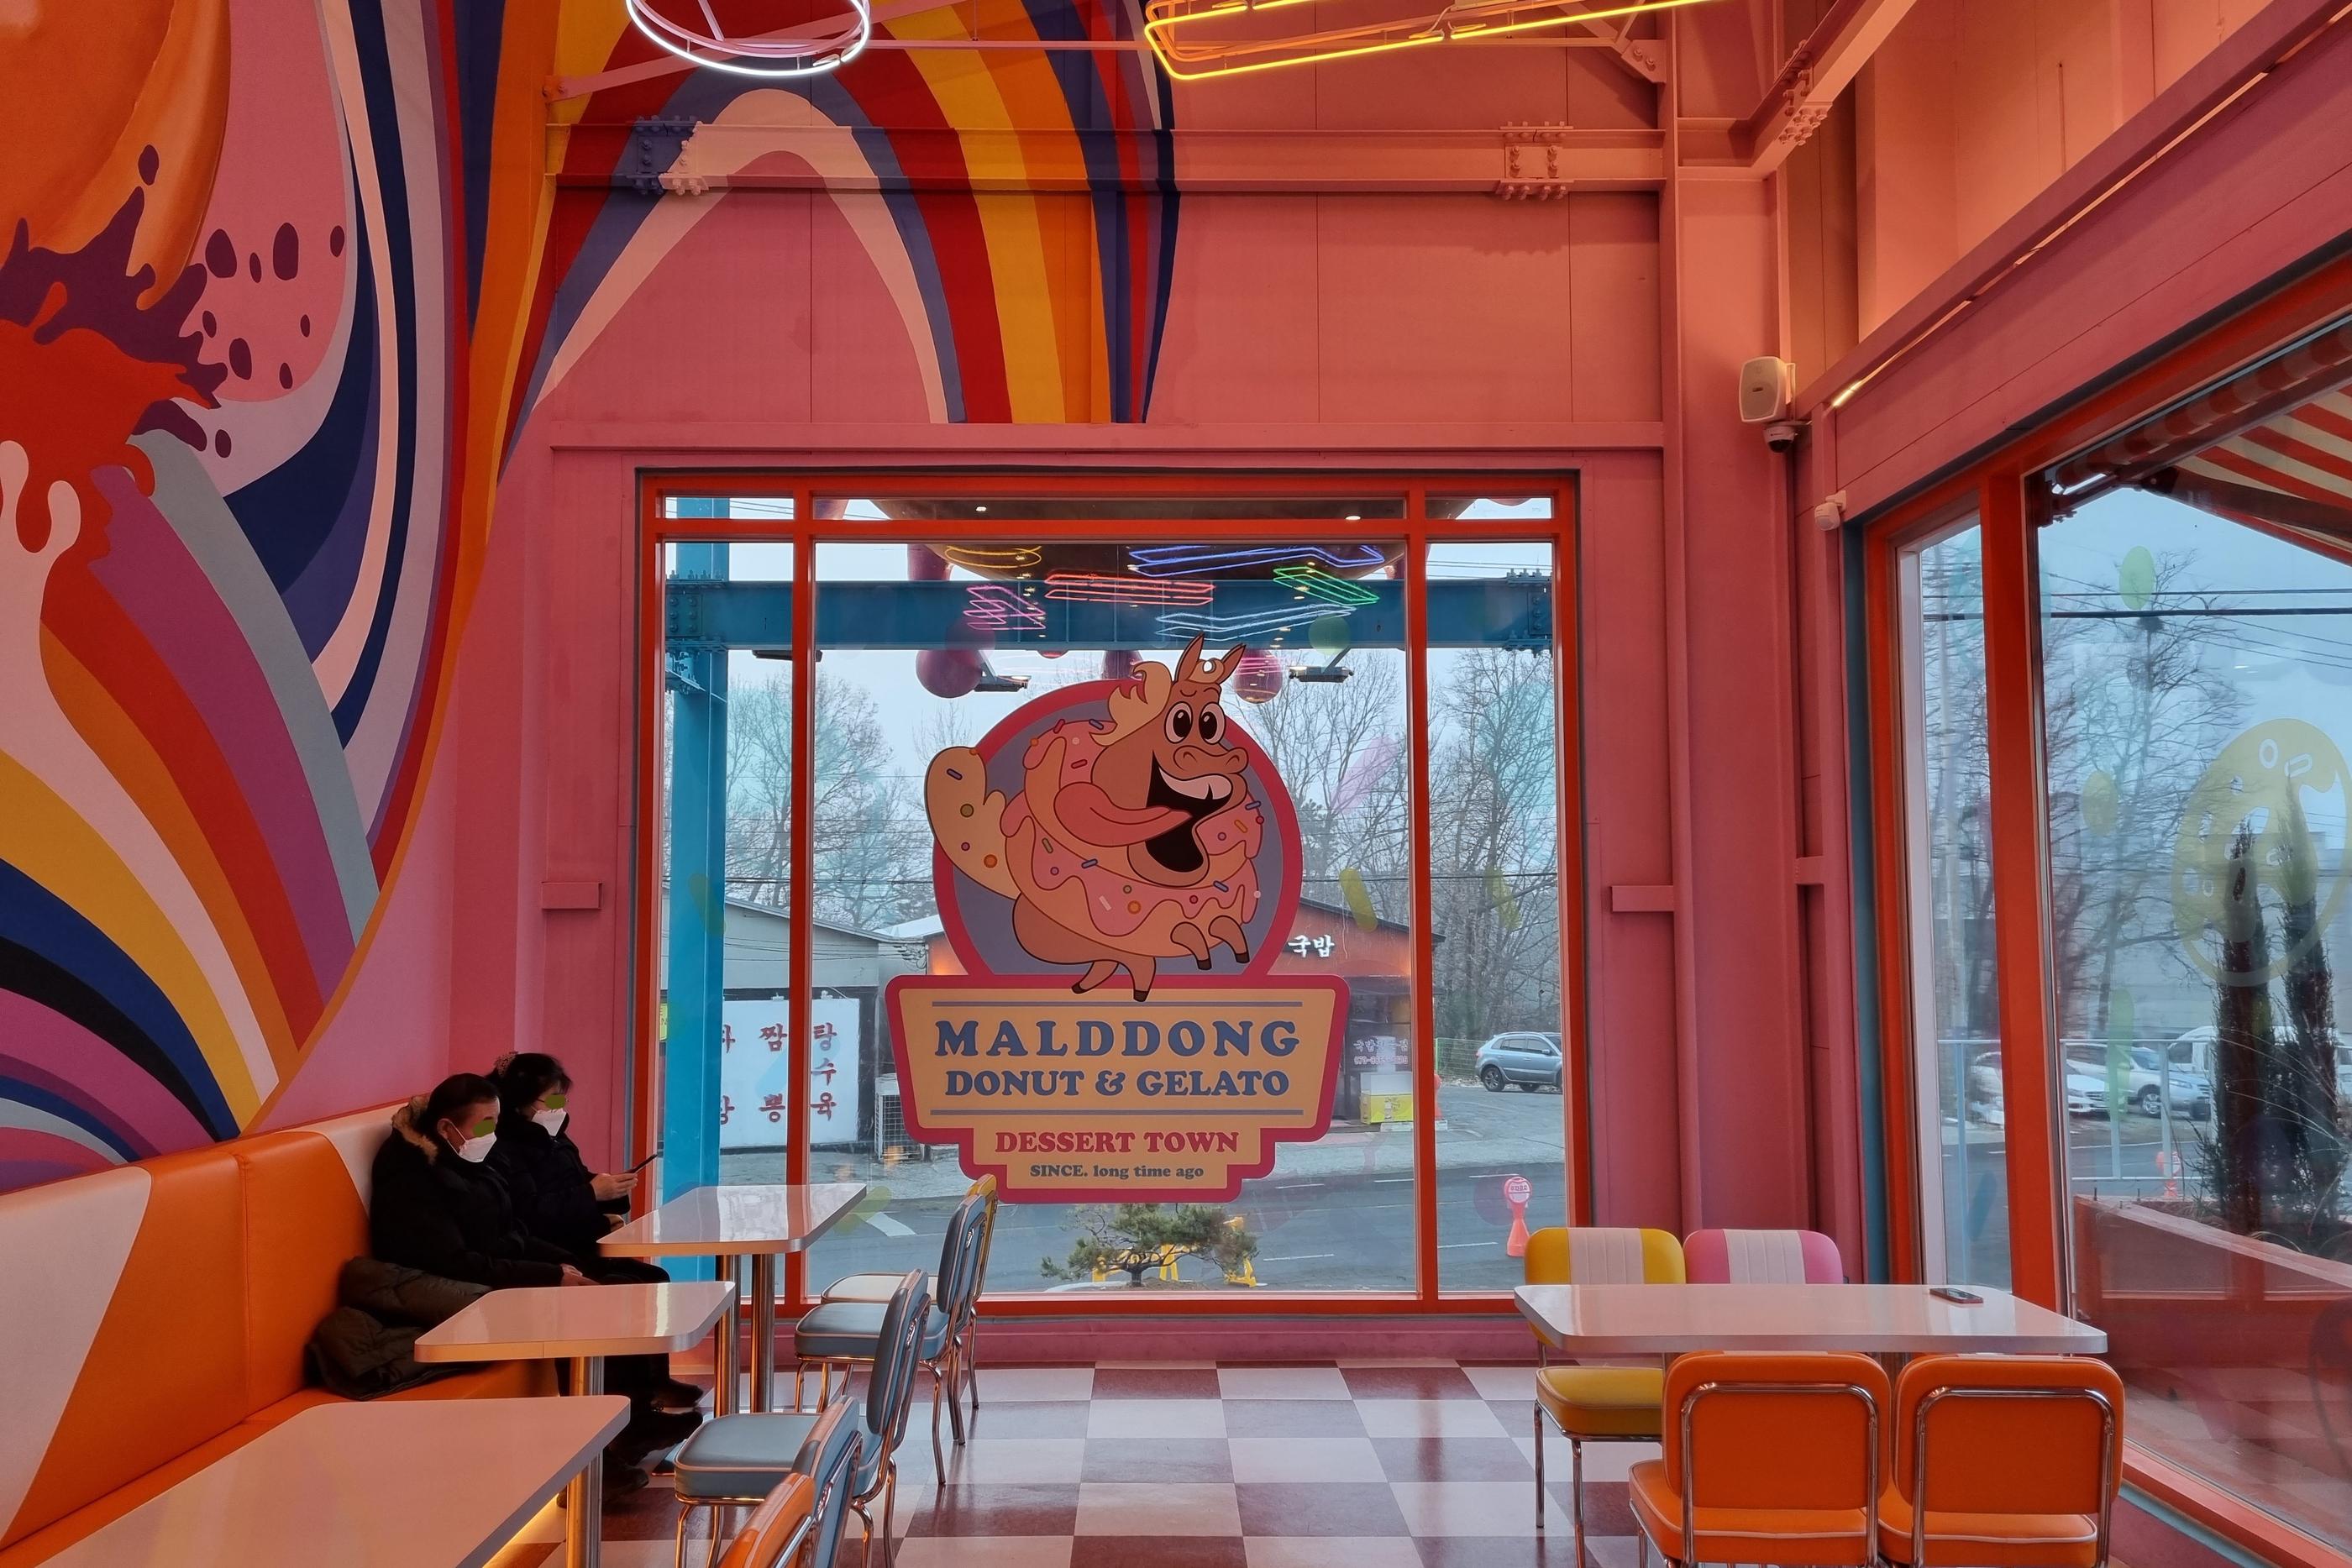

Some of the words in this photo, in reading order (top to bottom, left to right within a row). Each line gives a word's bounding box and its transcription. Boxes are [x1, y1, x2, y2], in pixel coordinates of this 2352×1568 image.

[1288, 934, 1336, 958] 국밥
[934, 1020, 1299, 1057] MALDDONG
[758, 1023, 788, 1123] 짬뽕
[810, 1022, 837, 1121] 탕수육
[945, 1070, 1084, 1096] DONUT
[1095, 1070, 1126, 1096] &
[1137, 1070, 1289, 1096] GELATO
[995, 1131, 1136, 1153] DESSERT
[1143, 1131, 1240, 1153] TOWN
[1030, 1164, 1089, 1177] SINCE.
[1093, 1164, 1130, 1180] long
[1133, 1164, 1171, 1177] time
[1175, 1167, 1205, 1180] ago
